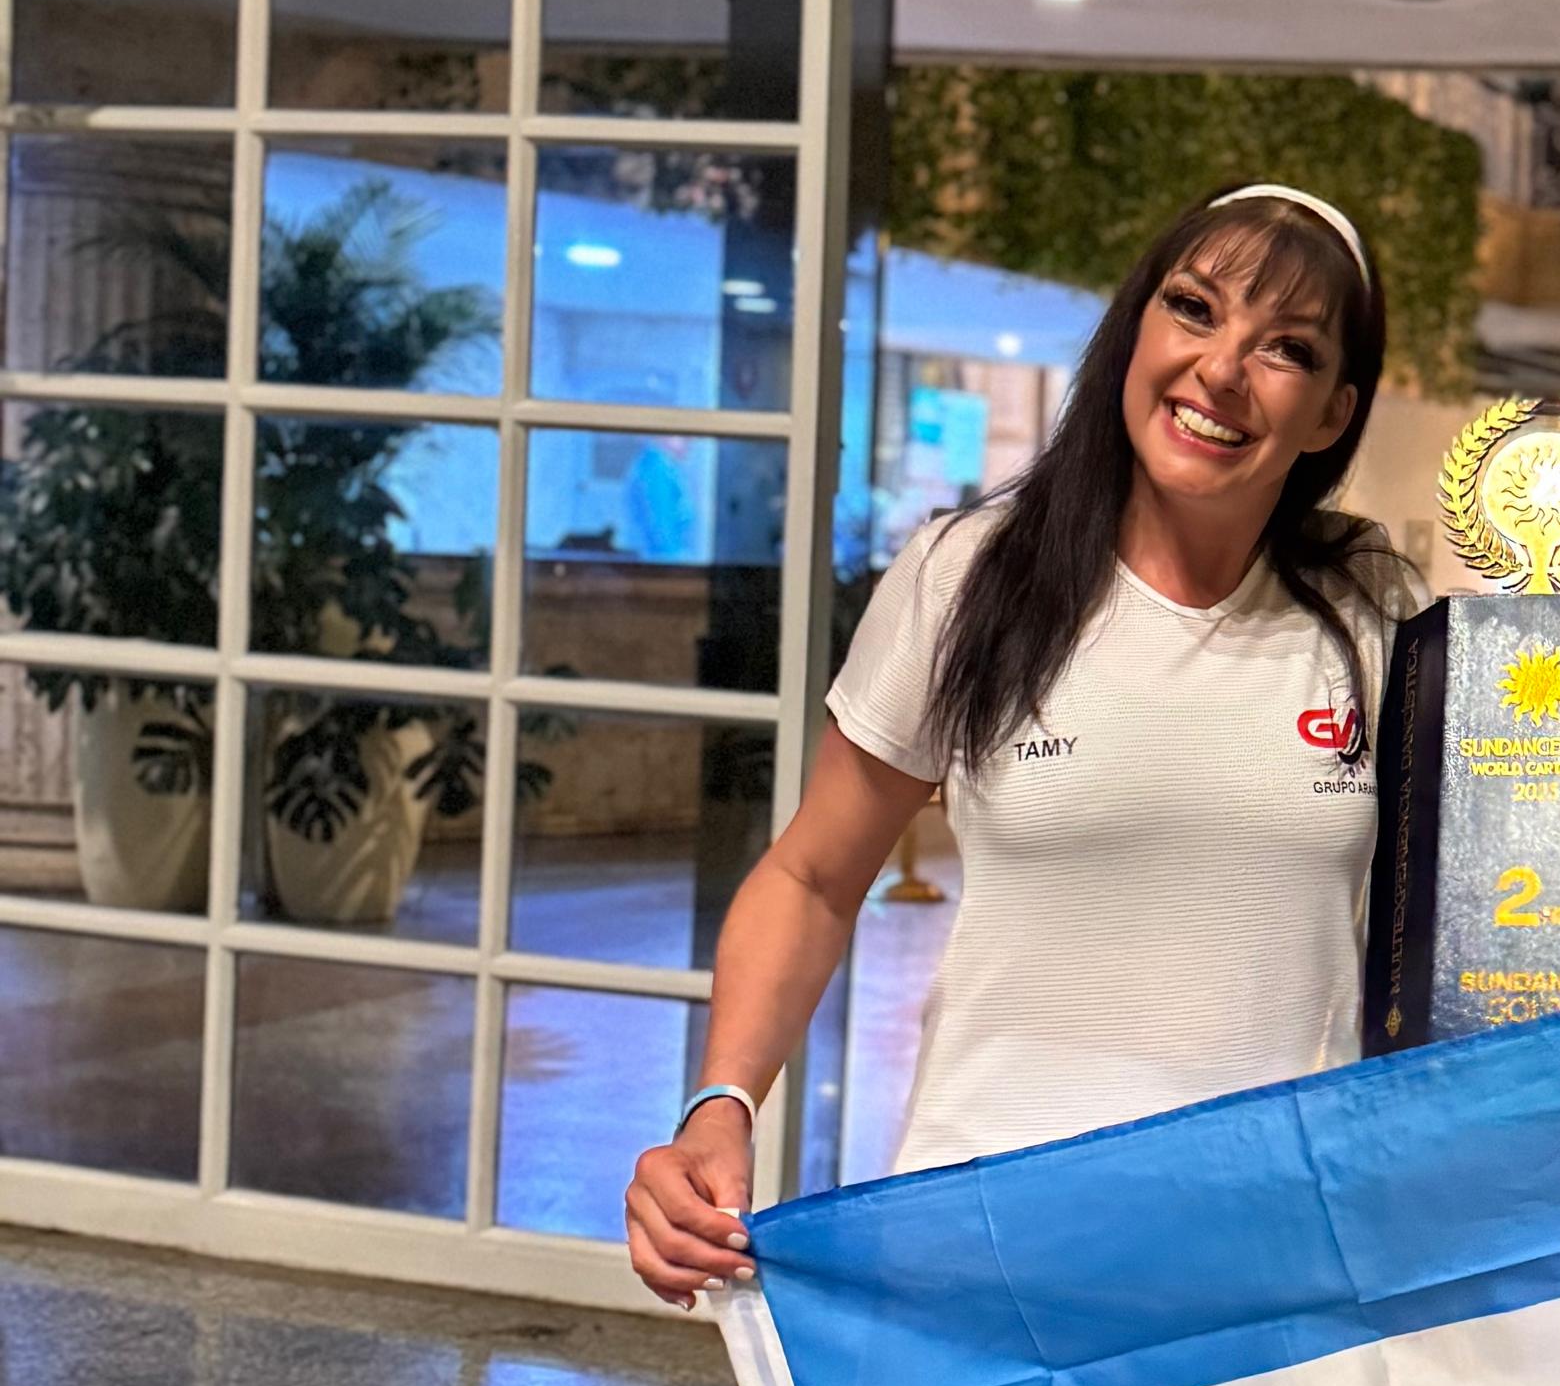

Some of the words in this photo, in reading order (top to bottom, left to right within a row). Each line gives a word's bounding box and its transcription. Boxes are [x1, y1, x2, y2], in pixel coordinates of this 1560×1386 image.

[1013, 736, 1078, 762] TAMY
[1470, 762, 1524, 777] WORLD
[1313, 781, 1356, 794] GRUPO
